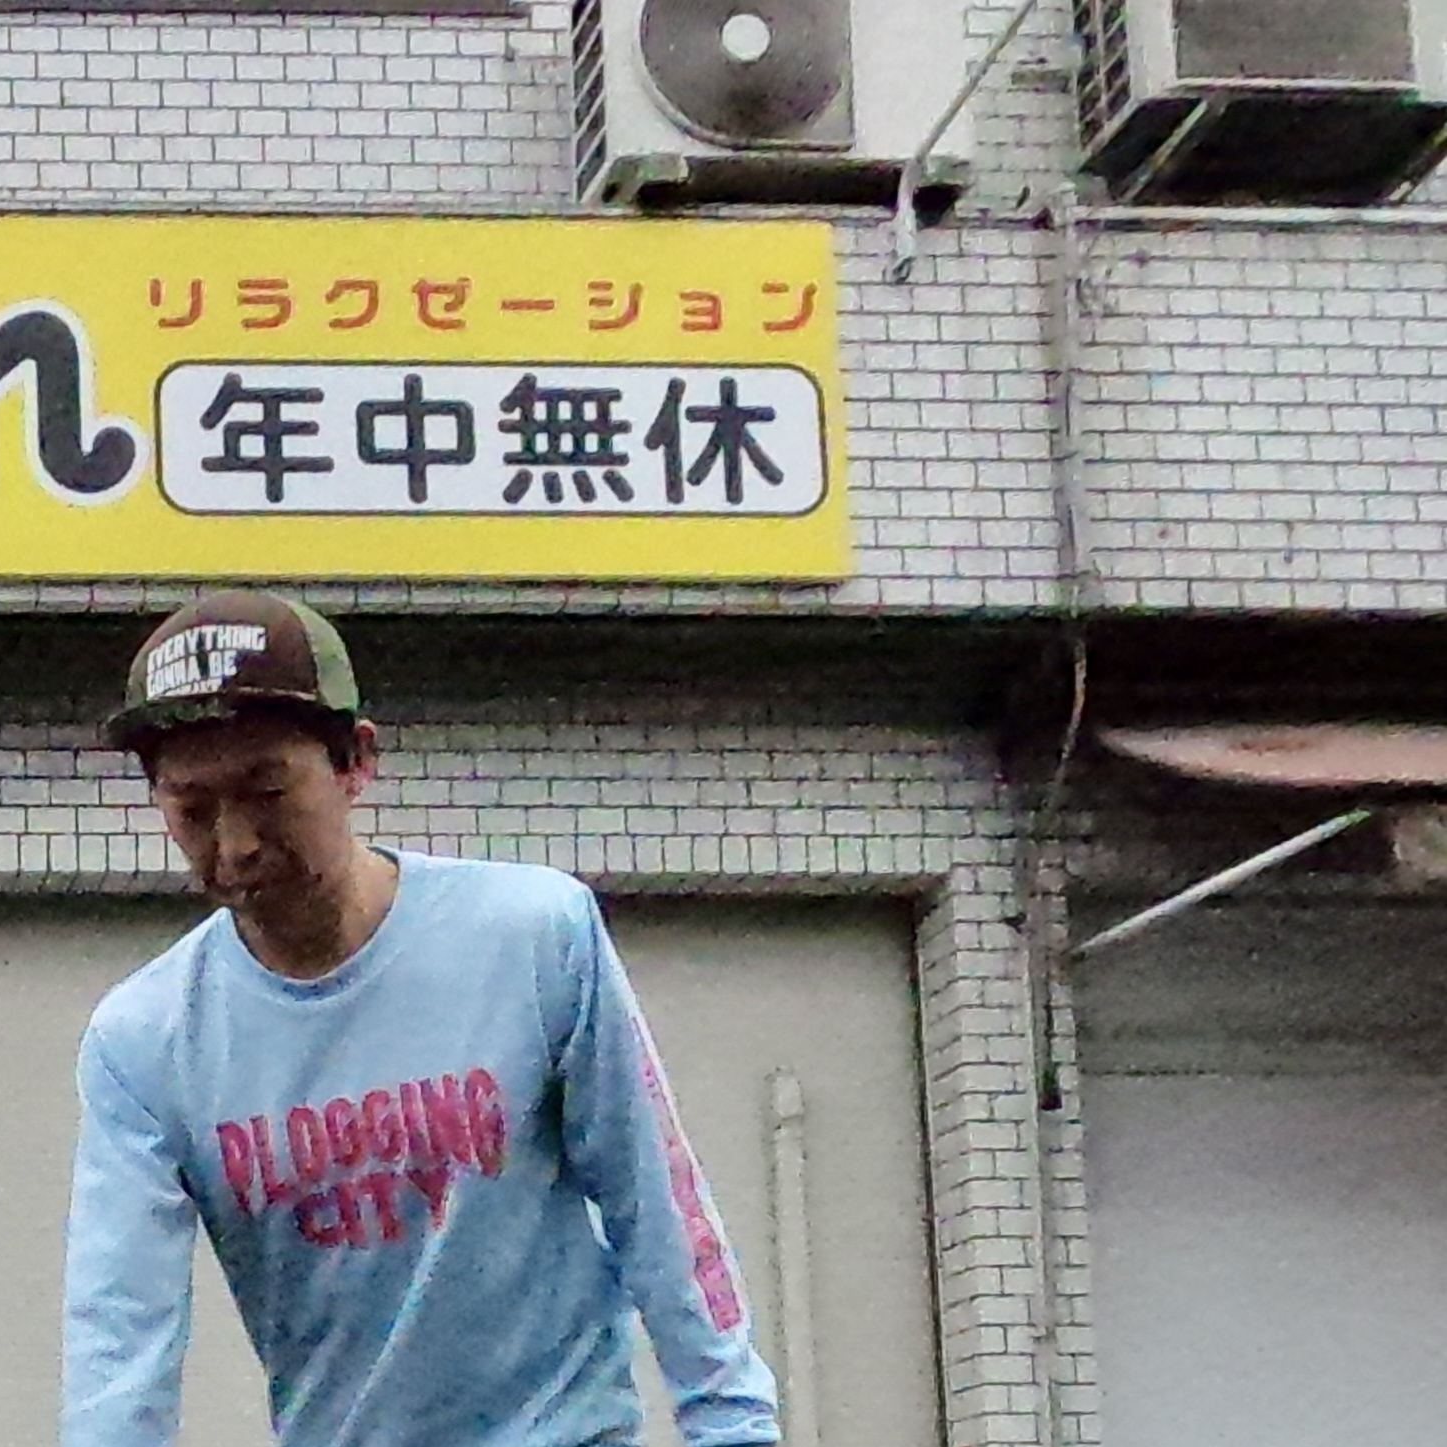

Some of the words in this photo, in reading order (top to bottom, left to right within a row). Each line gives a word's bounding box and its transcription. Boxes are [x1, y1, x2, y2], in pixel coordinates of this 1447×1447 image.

[148, 276, 819, 333] リラクゼーション
[198, 372, 786, 505] 年中無休
[208, 650, 238, 677] BE
[215, 1066, 506, 1216] PLOGGING
[292, 1167, 454, 1250] CITY
